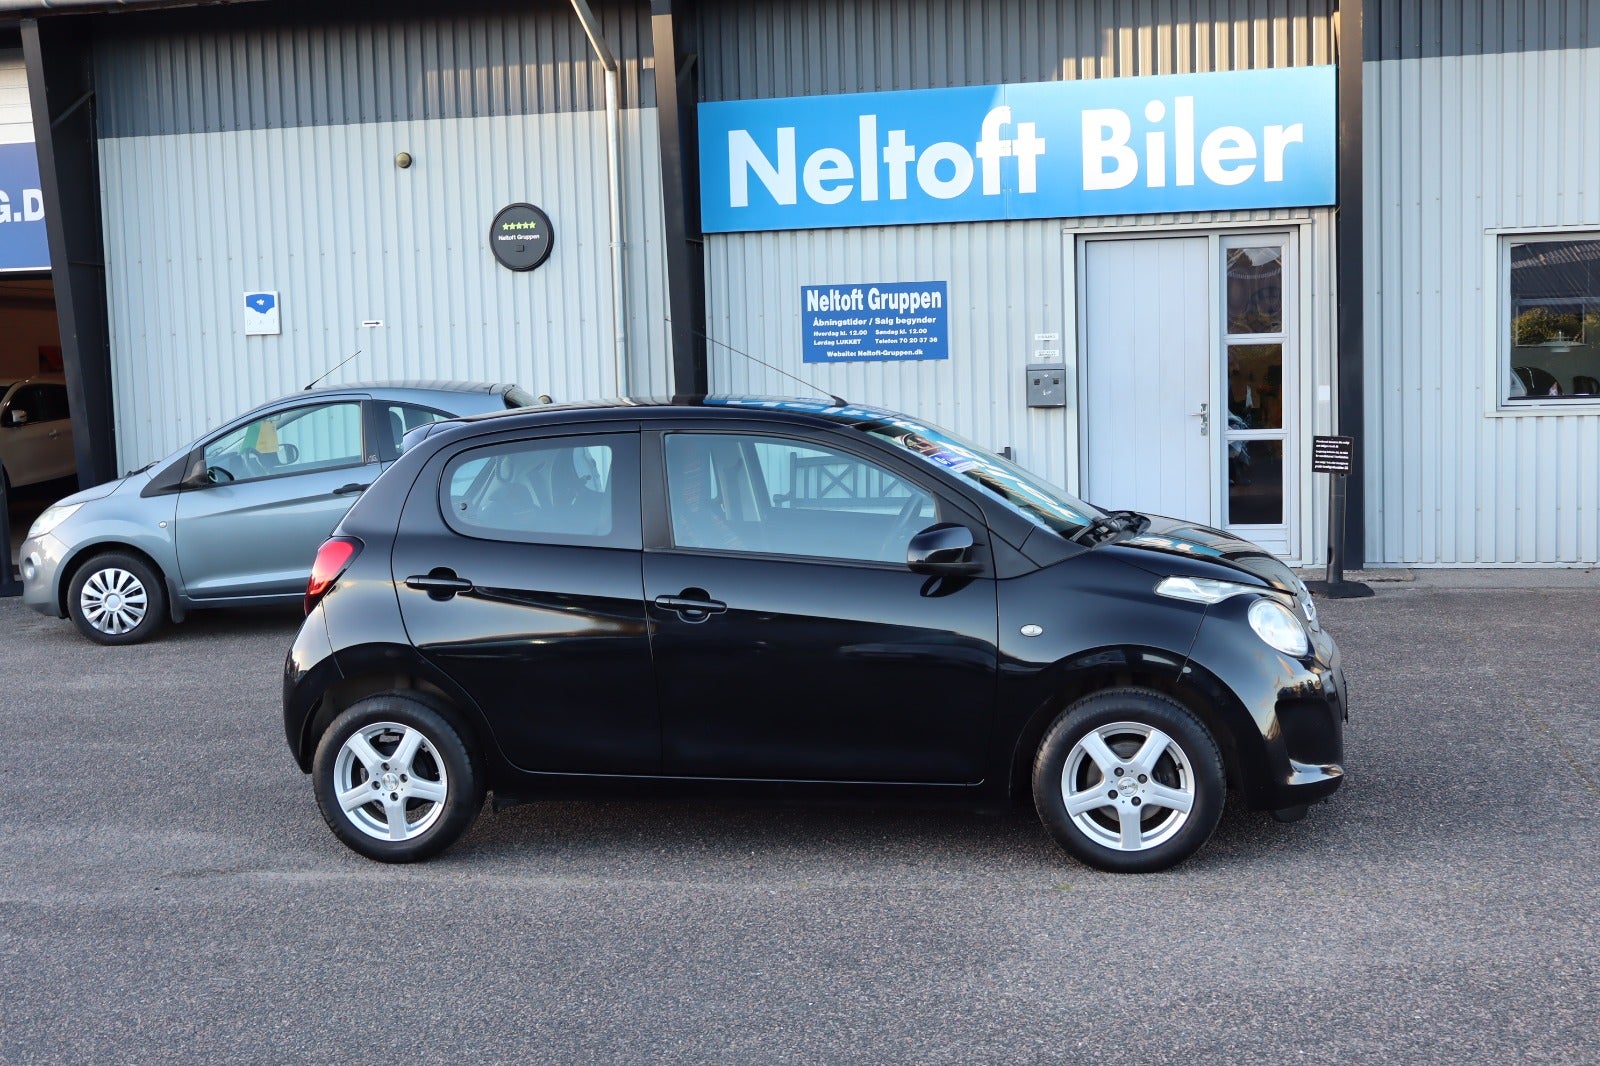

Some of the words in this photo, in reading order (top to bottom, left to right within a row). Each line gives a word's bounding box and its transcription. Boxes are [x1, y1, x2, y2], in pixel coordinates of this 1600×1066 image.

[728, 106, 1045, 208] Neltoft
[1082, 96, 1303, 191] Biler
[807, 289, 863, 311] Neltoft
[868, 288, 941, 314] Gruppen
[813, 317, 867, 327] Åbningstider
[875, 317, 893, 326] Salg
[896, 316, 936, 325] begynder
